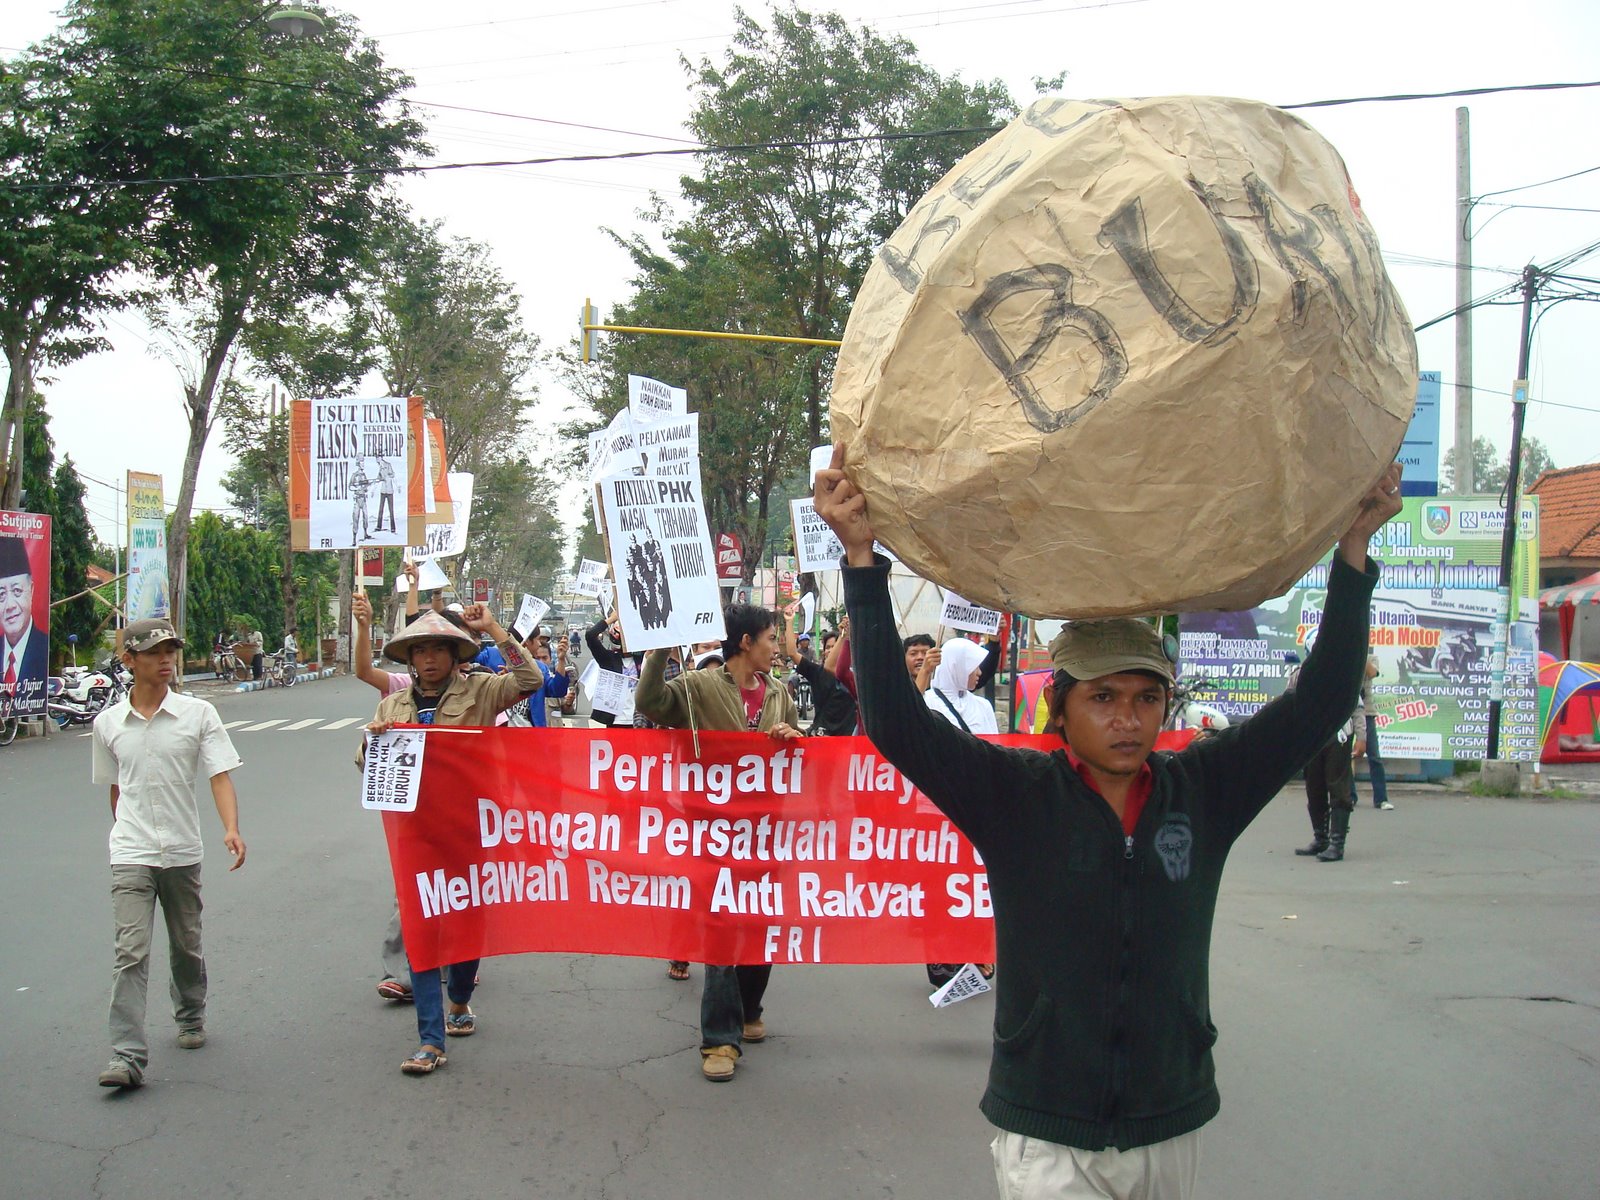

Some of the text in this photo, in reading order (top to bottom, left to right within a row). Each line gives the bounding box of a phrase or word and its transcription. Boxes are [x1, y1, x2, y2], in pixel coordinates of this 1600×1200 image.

[641, 381, 671, 399] NAIKKAN
[317, 404, 401, 423] USUT TUNTAS
[317, 424, 358, 459] KASUS
[639, 424, 691, 447] PELAYANAN
[363, 433, 404, 457] TERHADAP
[656, 461, 690, 476] RAKYAT
[317, 461, 348, 500] PETANI
[614, 480, 695, 506] HENTIKAN PHK
[653, 507, 699, 538] TERHADAP
[1480, 511, 1532, 519] BAN RI
[320, 538, 333, 548] FRI
[1386, 521, 1411, 547] BRI
[670, 542, 707, 578] BURUH
[1389, 544, 1454, 560] Jombang
[1375, 560, 1436, 589] Pemkab
[944, 603, 999, 627] PERBUDAKAN MODERN
[1431, 600, 1455, 608] BANK
[1458, 603, 1488, 613] RAKYAT
[694, 611, 714, 625] FRI
[1379, 611, 1416, 625] Utama
[1180, 640, 1267, 650] BUPATI JOMBANG
[1398, 627, 1440, 646] Motor
[1180, 649, 1204, 659] DRS.
[1232, 664, 1245, 677] 27
[1247, 664, 1282, 677] APRIL
[1467, 662, 1535, 673] LEMRI ES
[1238, 680, 1260, 690] WIB
[1448, 674, 1465, 684] TV
[1469, 675, 1512, 684] SHAP
[1228, 693, 1268, 702] FINISH
[1419, 686, 1474, 696] GUNUNG
[1457, 699, 1482, 709] VCD
[1507, 713, 1535, 722] COM
[1507, 738, 1536, 747] RICE
[1453, 749, 1536, 760] KITCHN SET
[367, 735, 385, 801] BERIKAN UPAH
[377, 742, 394, 802] SESUAI KHL
[590, 740, 805, 805] Peringati
[385, 766, 400, 802] KEPADA
[394, 769, 415, 804] BURUH
[478, 798, 959, 864] Dengan Persatuan Buruh
[416, 859, 568, 919] Melawan
[710, 867, 784, 916] Anti
[798, 872, 925, 918] Rakyat
[946, 873, 994, 918] SB
